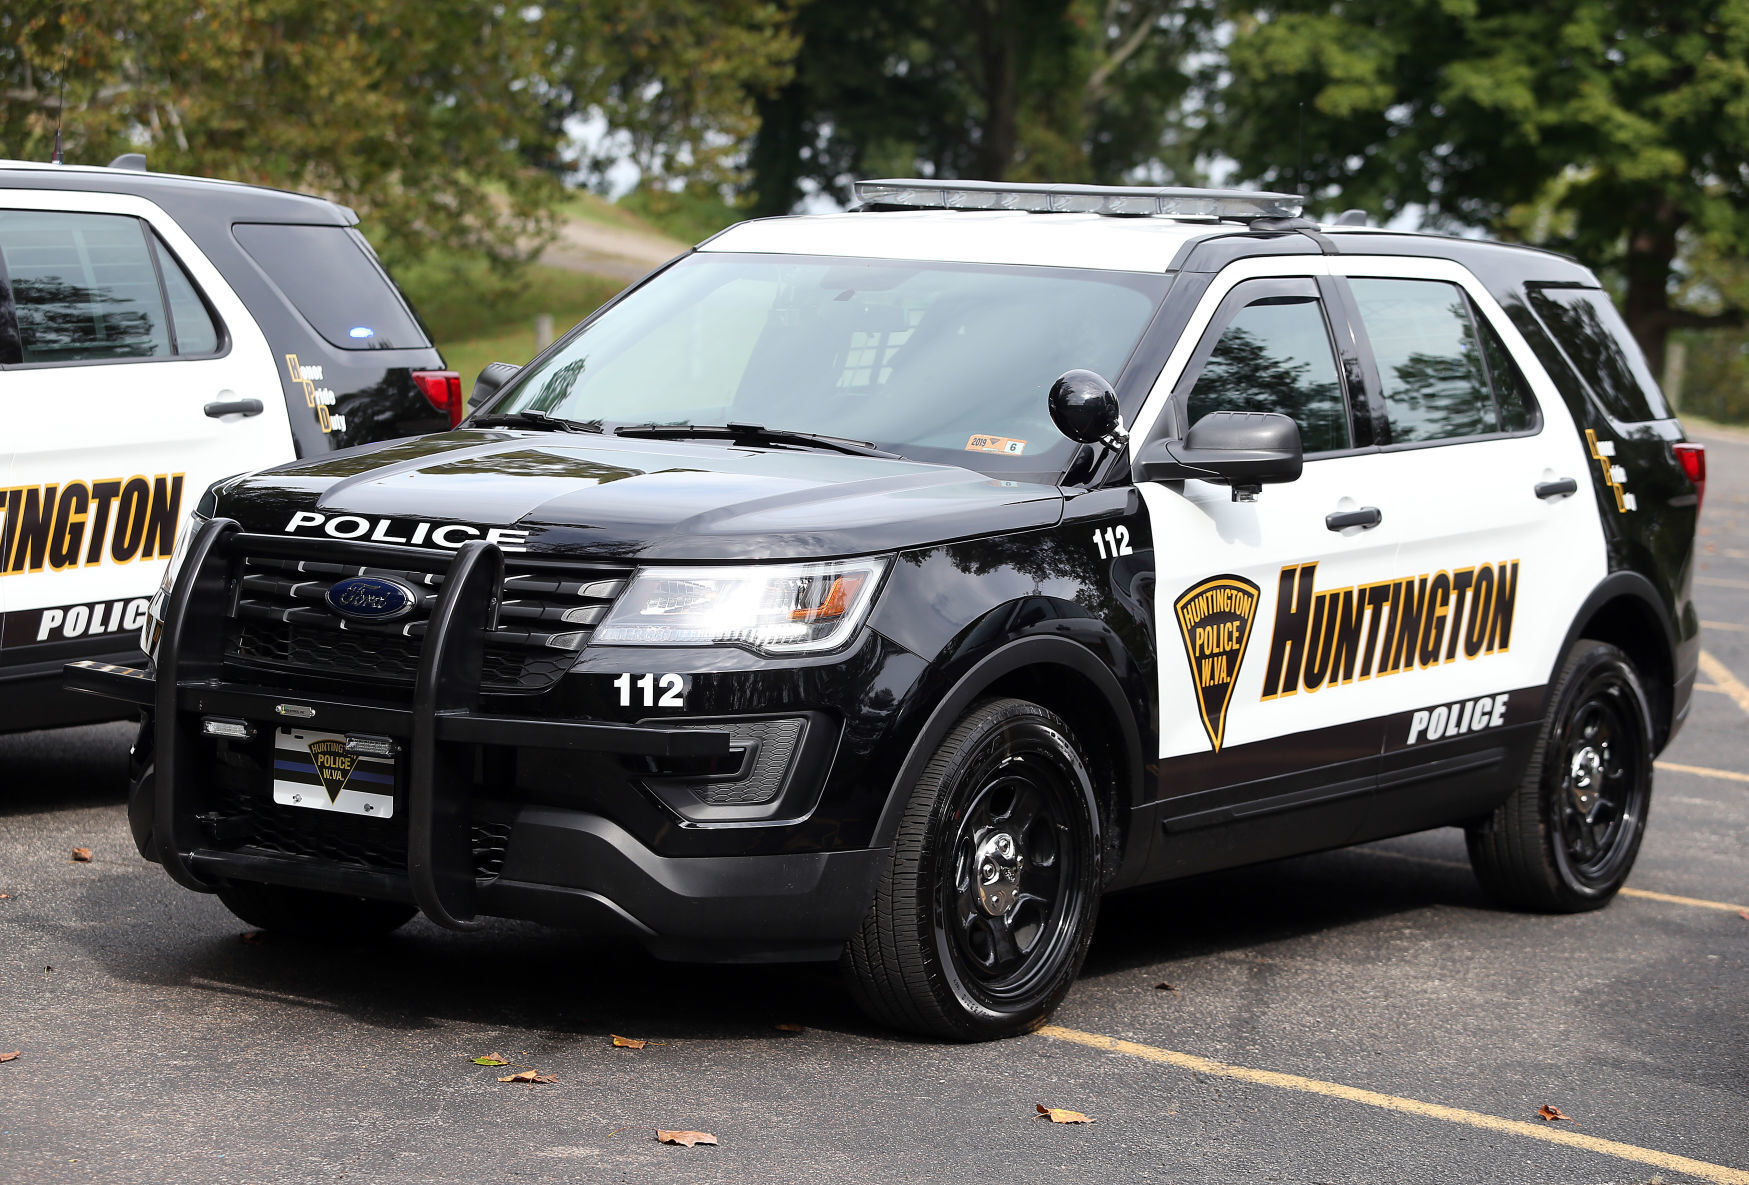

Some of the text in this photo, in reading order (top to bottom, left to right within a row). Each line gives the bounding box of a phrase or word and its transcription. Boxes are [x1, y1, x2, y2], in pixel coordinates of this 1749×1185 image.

[285, 354, 323, 382] Honor
[302, 380, 336, 408] Pride
[317, 404, 346, 434] Duty
[971, 437, 1017, 452] 2019 6
[0, 472, 185, 577] INGTON
[284, 510, 530, 553] POLICE
[1092, 524, 1133, 559] 112
[341, 582, 391, 609] Ford
[1183, 588, 1251, 629] HUNTINGTON
[36, 598, 149, 642] POLIC
[1260, 558, 1520, 703] HUNTINGTON
[1195, 620, 1241, 657] POLICE
[1201, 655, 1230, 687] W.VA.
[613, 672, 684, 707] 112
[1406, 693, 1508, 745] POLICE
[311, 742, 358, 759] HUNTING
[317, 754, 351, 770] POLICE
